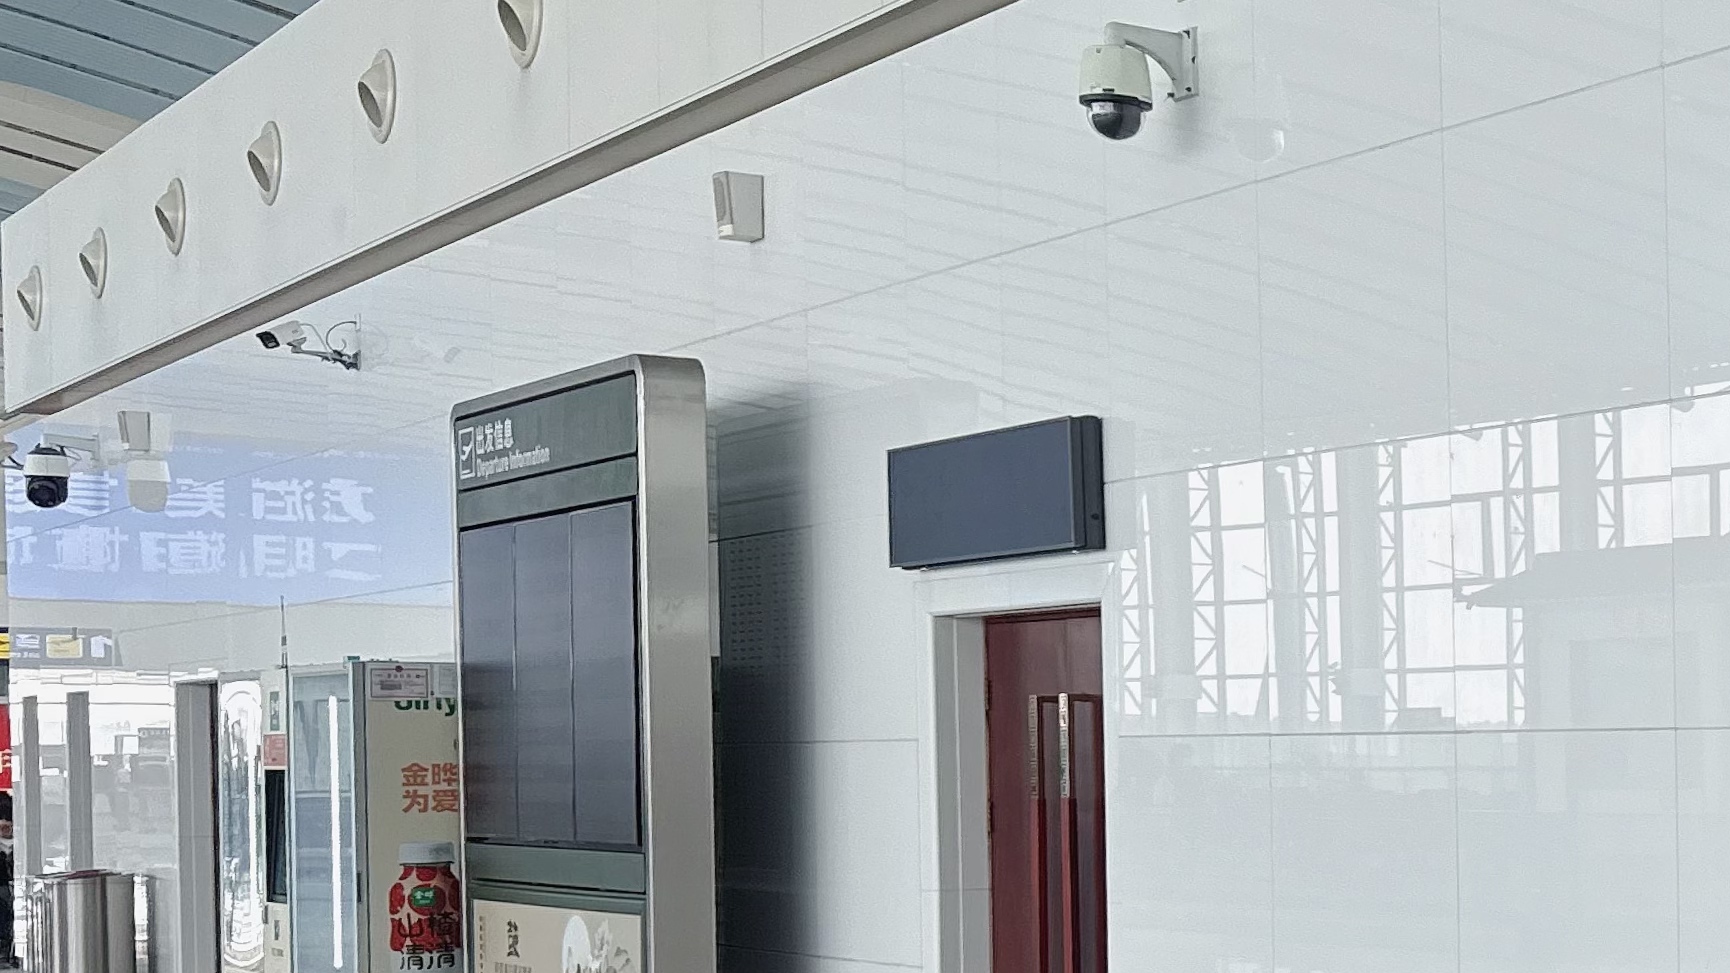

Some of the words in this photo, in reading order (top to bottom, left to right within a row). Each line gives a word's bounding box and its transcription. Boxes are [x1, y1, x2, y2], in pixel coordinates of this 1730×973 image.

[476, 417, 514, 455] 出发信息
[476, 455, 509, 480] Departure
[509, 444, 550, 470] Information
[401, 789, 459, 813] 为爱
